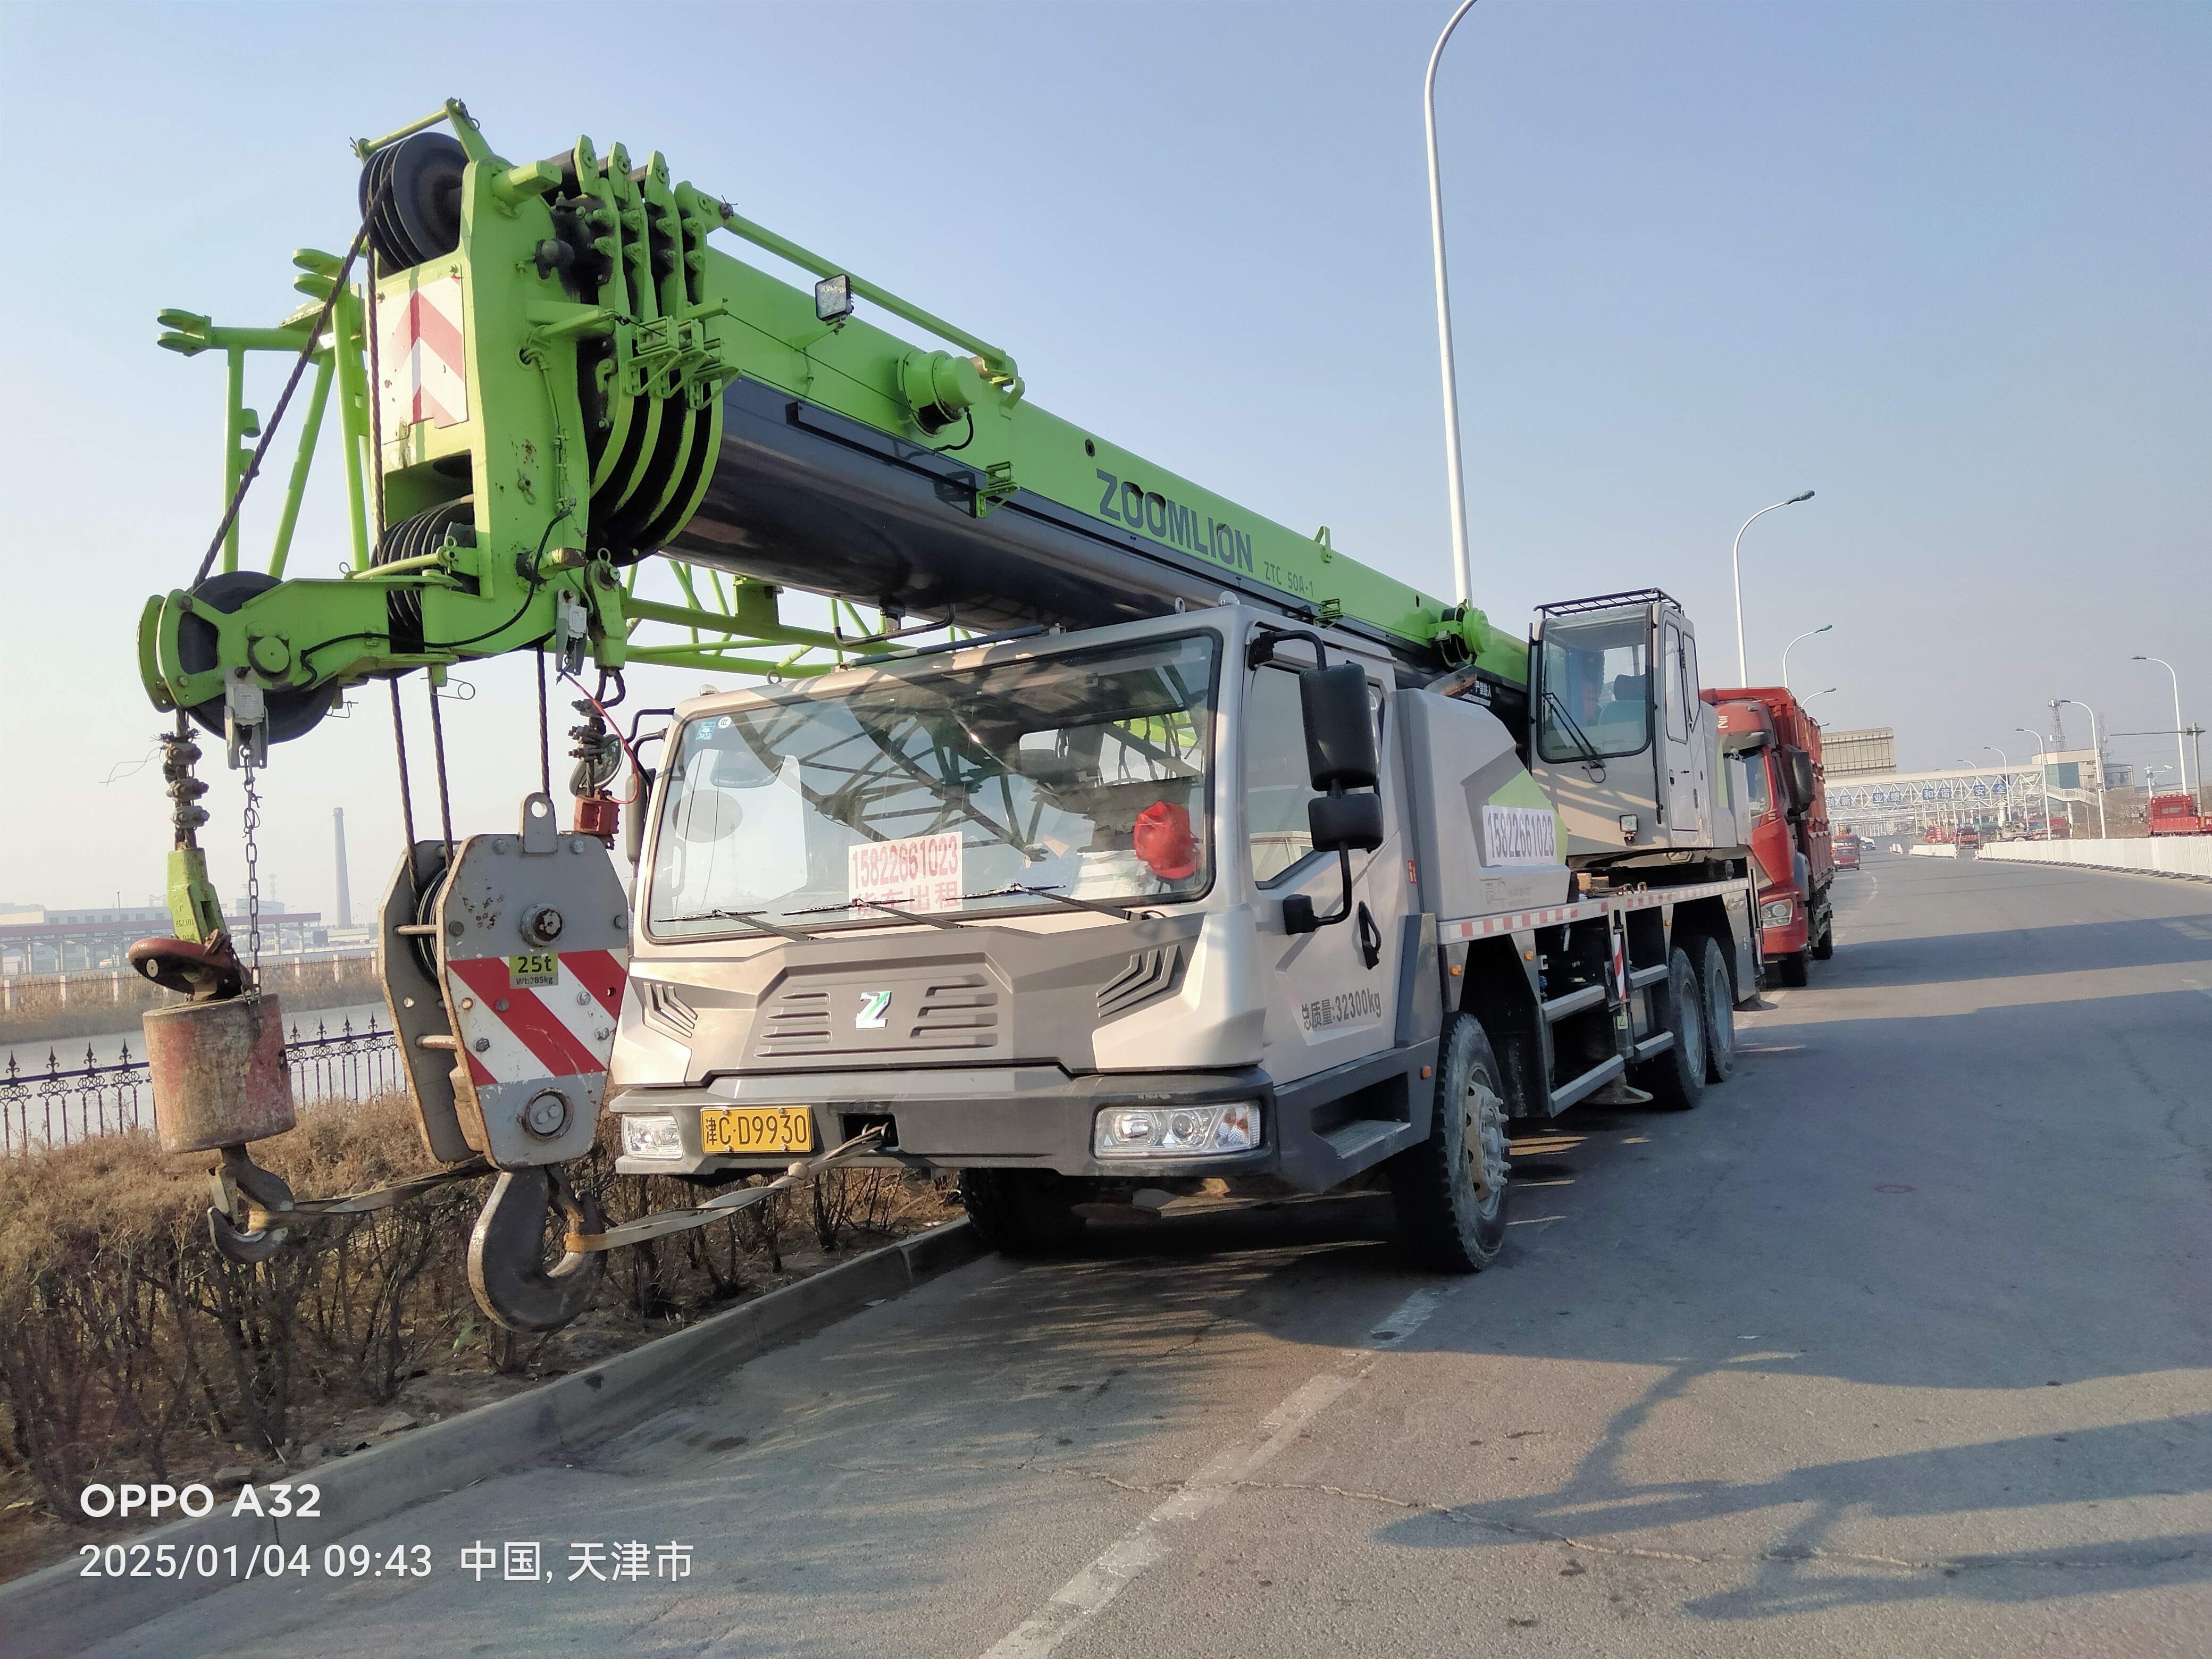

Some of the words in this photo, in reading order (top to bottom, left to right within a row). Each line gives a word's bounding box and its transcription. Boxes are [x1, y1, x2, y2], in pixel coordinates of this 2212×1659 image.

[1096, 468, 1254, 573] ZOOMLION
[1264, 560, 1282, 585] ZTC
[1873, 792, 1900, 803] 业绩
[1923, 787, 1951, 799] 和谐
[1974, 784, 2006, 796] 安全
[1488, 812, 1554, 858] 15822661023
[852, 835, 958, 890] 15822661023
[518, 956, 552, 973] 25t
